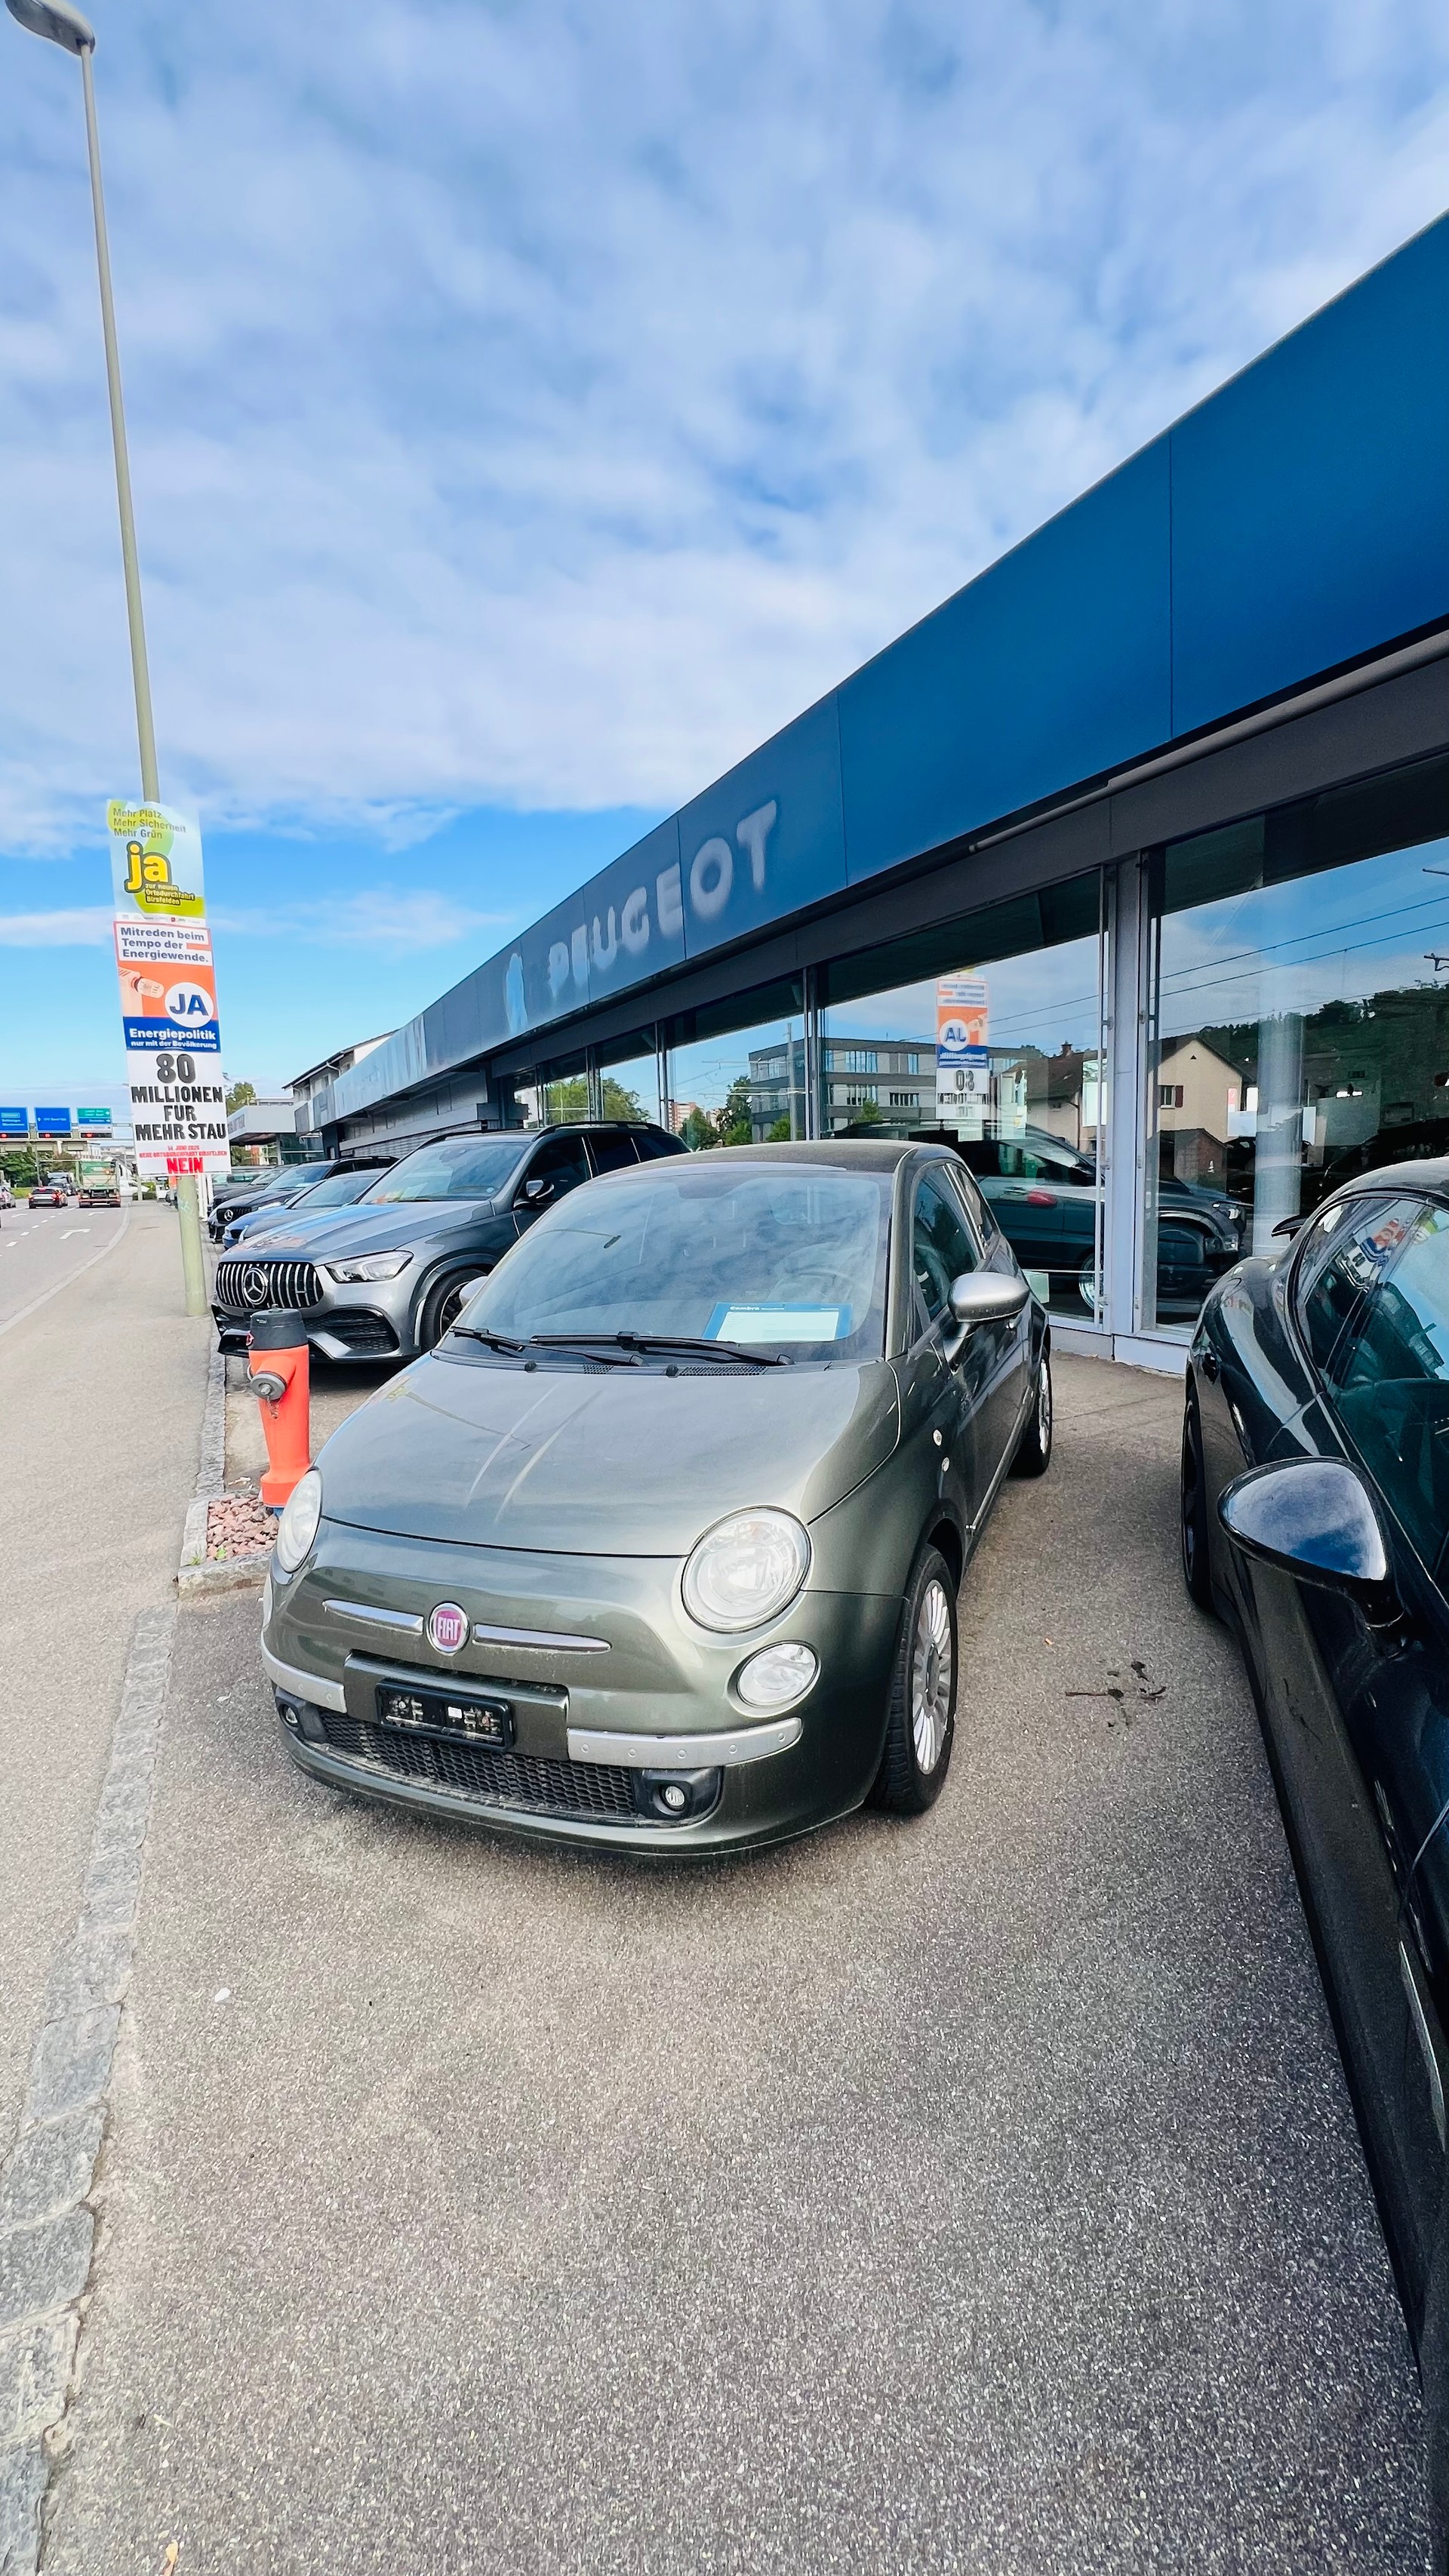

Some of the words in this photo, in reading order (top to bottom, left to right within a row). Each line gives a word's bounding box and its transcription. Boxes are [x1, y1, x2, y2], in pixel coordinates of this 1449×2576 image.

[113, 808, 137, 817] Mehr
[139, 809, 162, 819] Platz
[113, 818, 137, 827] Mehr
[140, 819, 186, 833] Sicherheit
[114, 828, 137, 837] Mehr
[140, 829, 163, 839] Grün
[126, 842, 171, 891] ja
[146, 896, 180, 905] Birsfelden
[121, 927, 174, 938] Mitreden
[177, 931, 205, 941] beim
[122, 938, 161, 949] Tempo
[164, 940, 183, 949] der
[122, 949, 209, 963] Energiewende.
[169, 993, 209, 1017] JA
[129, 1028, 217, 1041] Energiepolitik
[172, 1041, 217, 1050] Bevölkerung
[156, 1053, 196, 1084] 80
[131, 1086, 223, 1103] MILLIONEN
[163, 1103, 197, 1122] FÜR
[135, 1123, 186, 1140] MEHR
[188, 1123, 227, 1140] STAU
[167, 1157, 204, 1174] NEIN
[437, 1617, 460, 1641] FIAT
